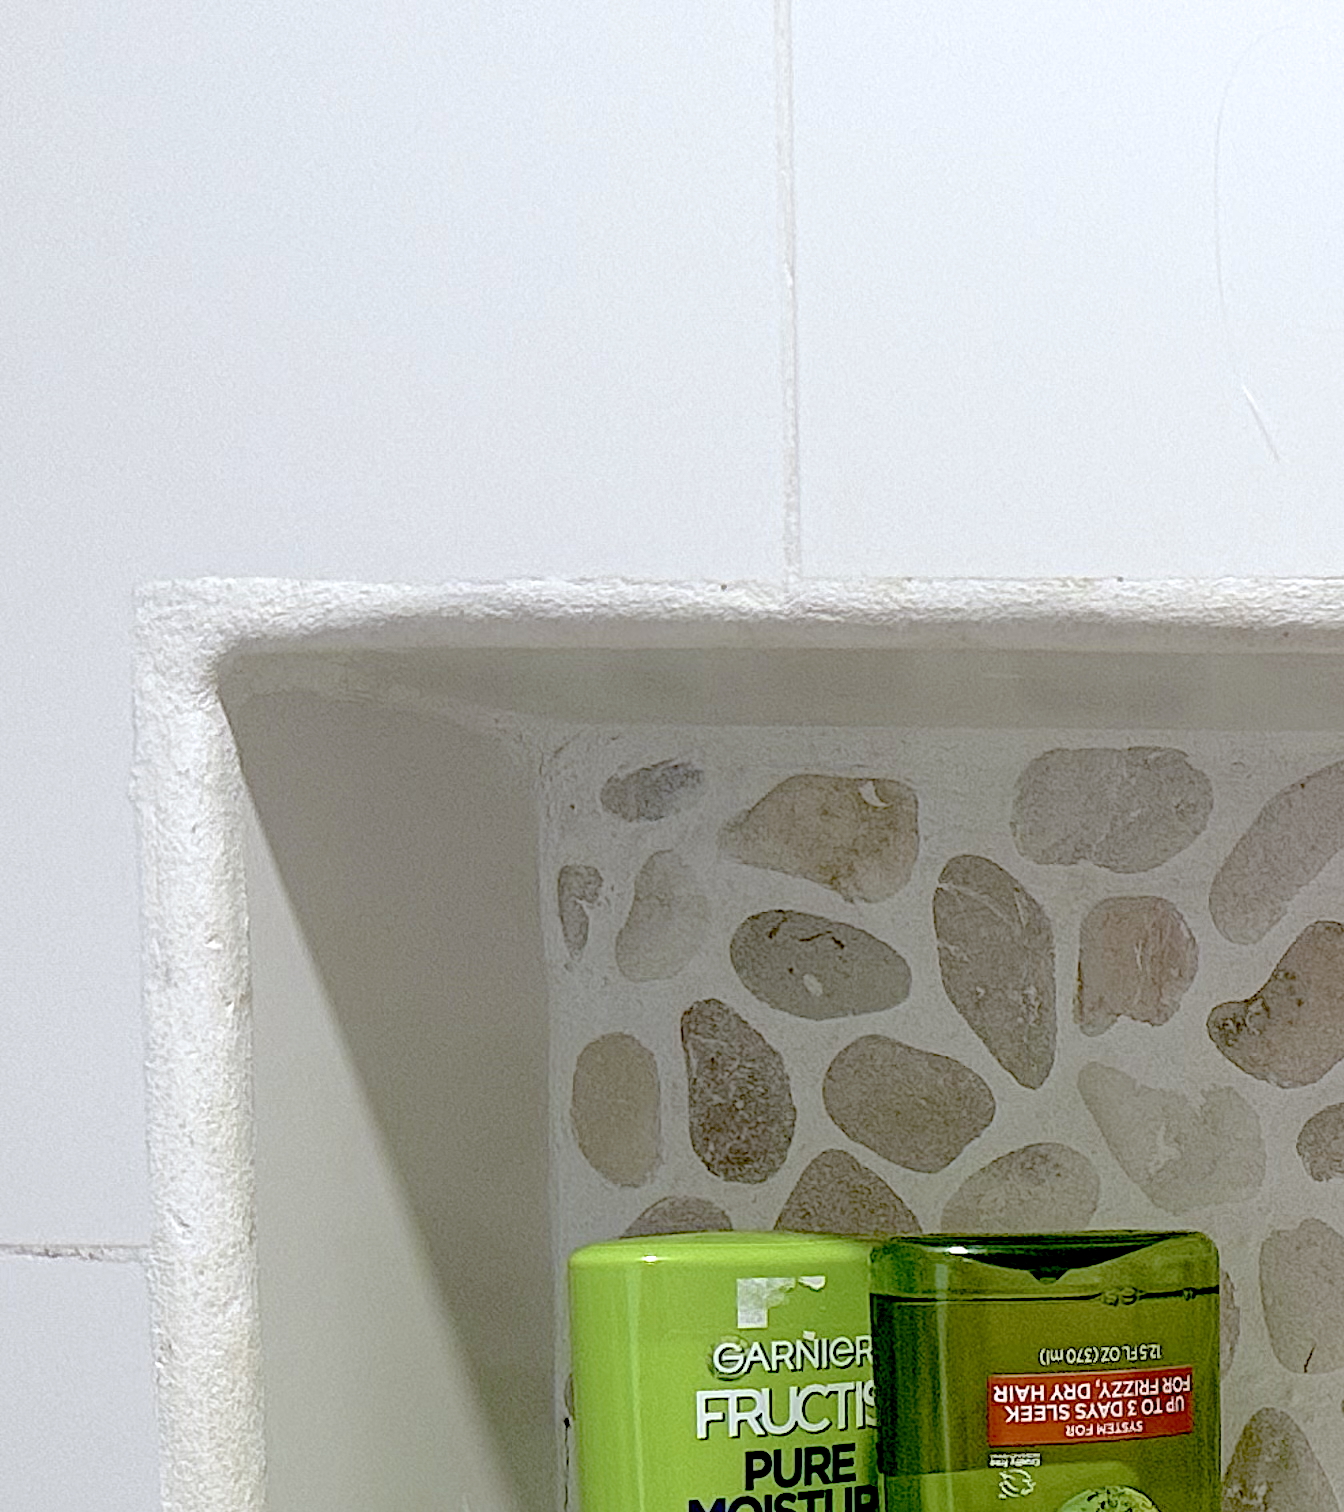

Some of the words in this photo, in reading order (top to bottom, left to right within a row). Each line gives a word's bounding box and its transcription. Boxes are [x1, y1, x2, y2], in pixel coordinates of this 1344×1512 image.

[712, 1335, 873, 1375] GARNIER
[1039, 1347, 1064, 1366] ml)
[1065, 1346, 1100, 1365] (370
[1100, 1346, 1121, 1363] OZ
[1121, 1345, 1138, 1361] FL
[1050, 1383, 1091, 1401] DRY
[1095, 1378, 1160, 1399] FRIZZY,
[1162, 1374, 1191, 1392] FOR
[993, 1384, 1046, 1403] HAIR
[1075, 1401, 1124, 1419] DAYS
[1127, 1402, 1137, 1416] 3
[1141, 1398, 1163, 1415] TO
[1165, 1395, 1185, 1413] UP
[1005, 1404, 1071, 1424] SLEEK
[1065, 1424, 1094, 1437] FOR
[1097, 1421, 1143, 1436] SYSTEM
[745, 1443, 857, 1491] PURE
